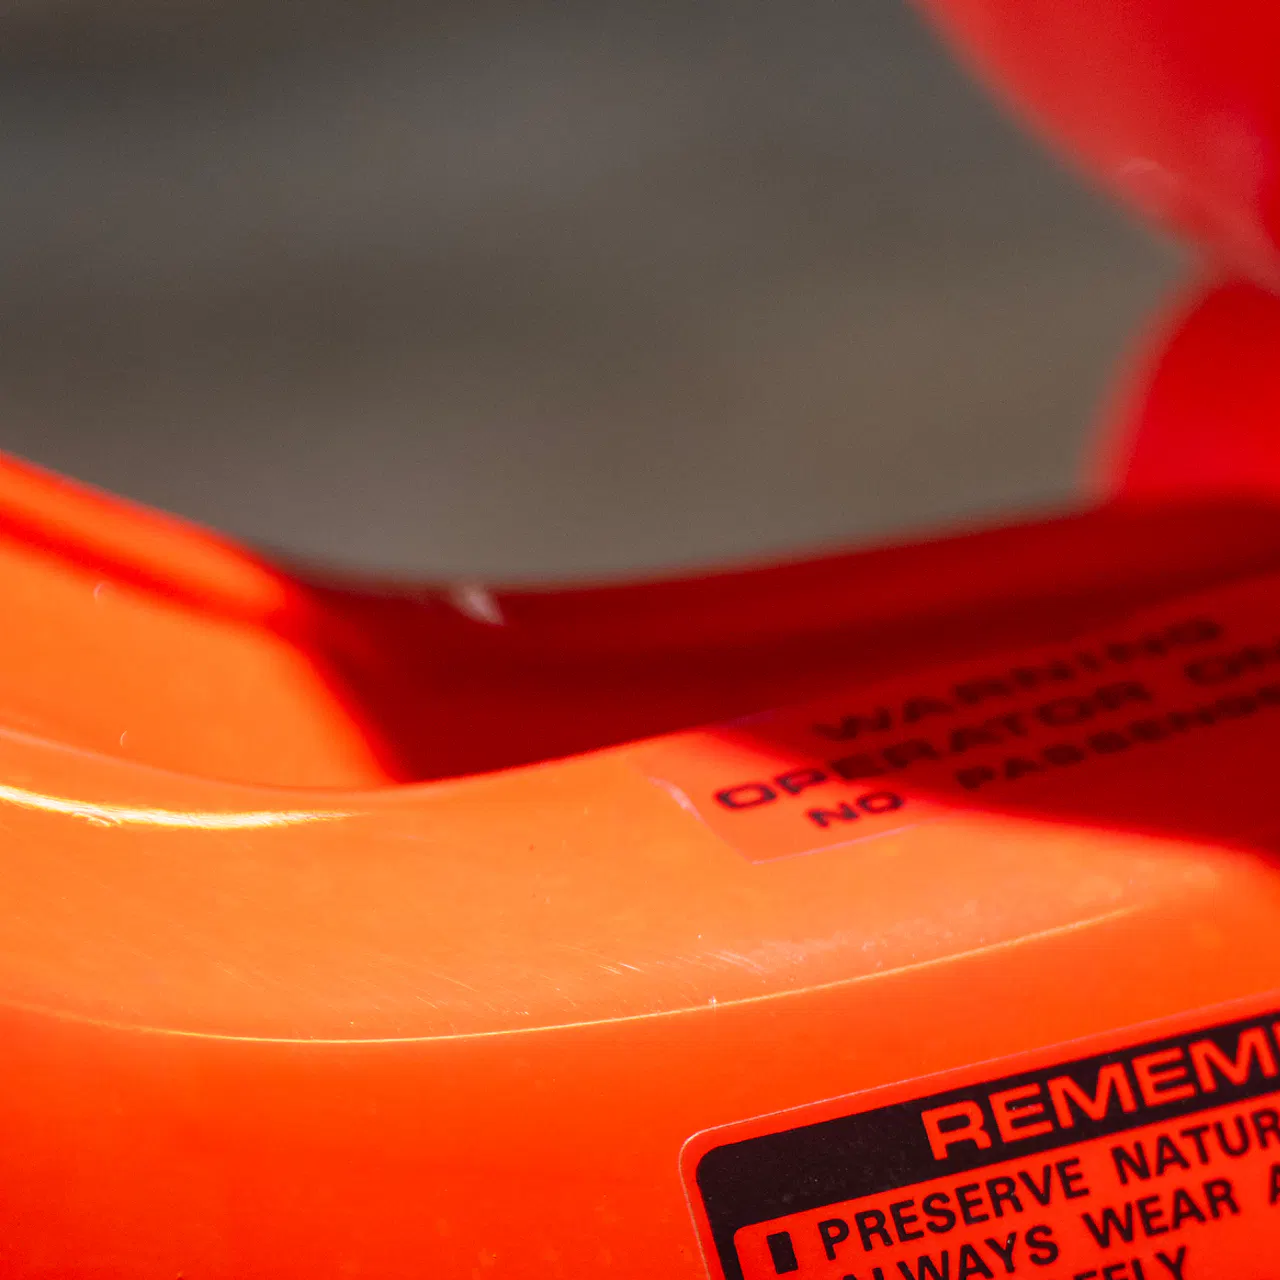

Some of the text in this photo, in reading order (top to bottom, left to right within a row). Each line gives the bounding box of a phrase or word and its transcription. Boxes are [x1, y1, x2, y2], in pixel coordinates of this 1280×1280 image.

[715, 681, 1151, 810] OPERATOR
[808, 790, 905, 828] NO
[818, 1158, 1090, 1261] PRESERVE
[1081, 1178, 1242, 1250] WEAR
